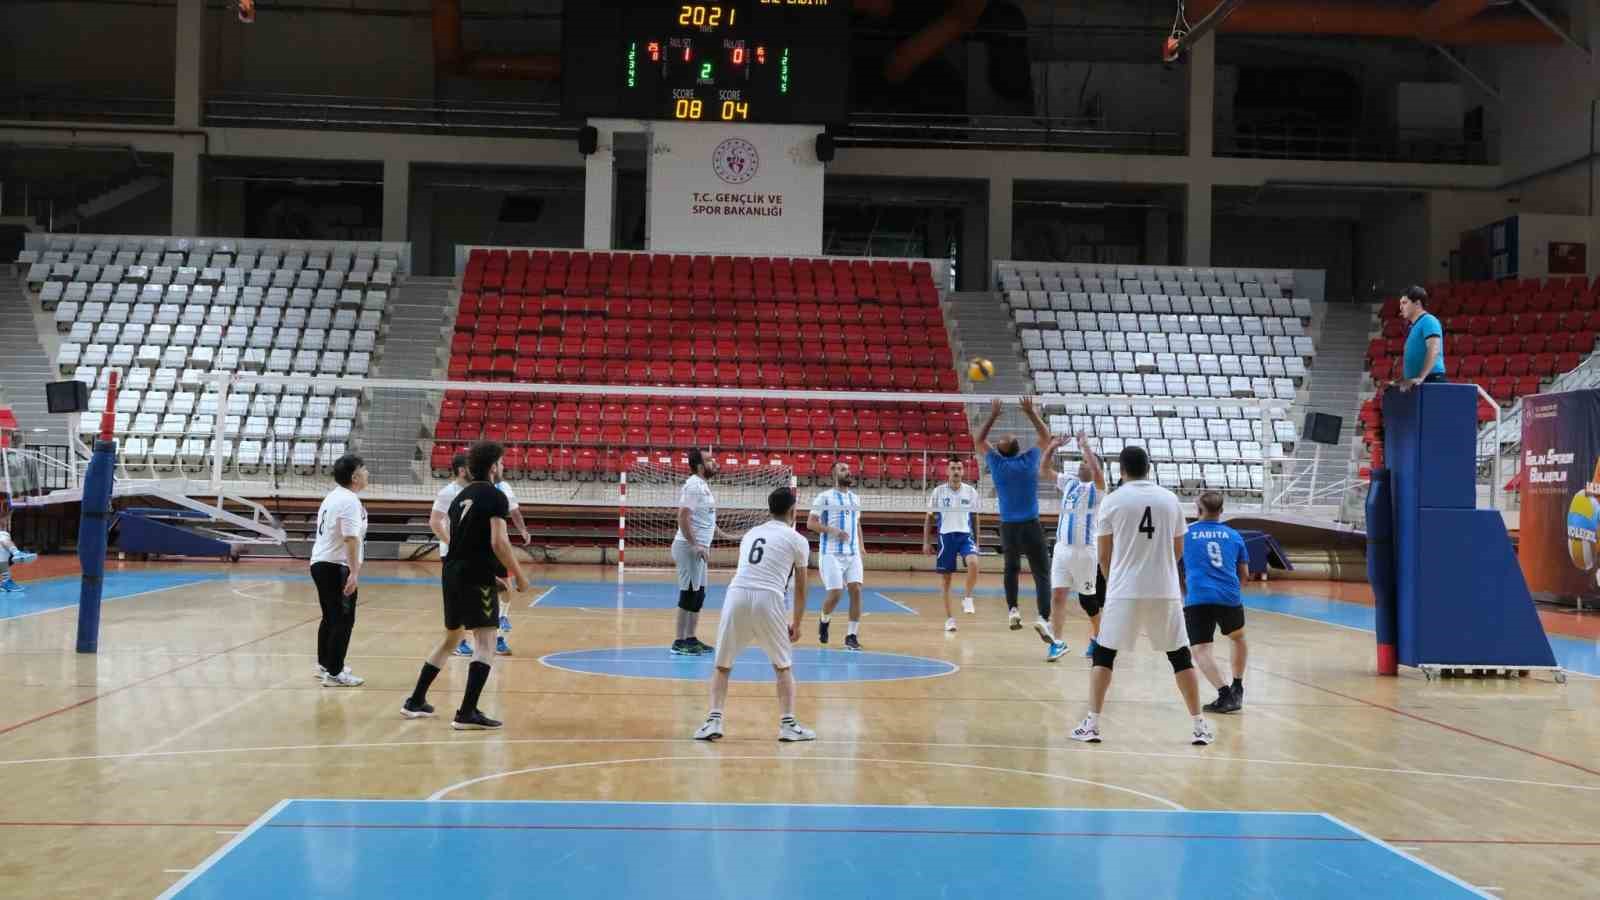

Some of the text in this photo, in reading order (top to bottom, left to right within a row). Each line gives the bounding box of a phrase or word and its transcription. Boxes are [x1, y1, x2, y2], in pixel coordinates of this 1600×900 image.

[679, 6, 735, 26] 2021
[684, 48, 690, 61] 1
[732, 48, 743, 64] 0
[701, 63, 712, 79] 2
[672, 89, 695, 99] SCORE
[720, 90, 741, 101] SCORE
[676, 99, 703, 119] 08
[722, 101, 748, 120] 04
[692, 192, 783, 205] T.C. GENÇLİK VE
[692, 205, 783, 217] SPOR BAKANLIĞI
[459, 499, 473, 521] 7
[1138, 506, 1155, 540] 4
[1191, 530, 1230, 540] ZABITA
[748, 538, 767, 564] 6
[1207, 541, 1223, 568] 9
